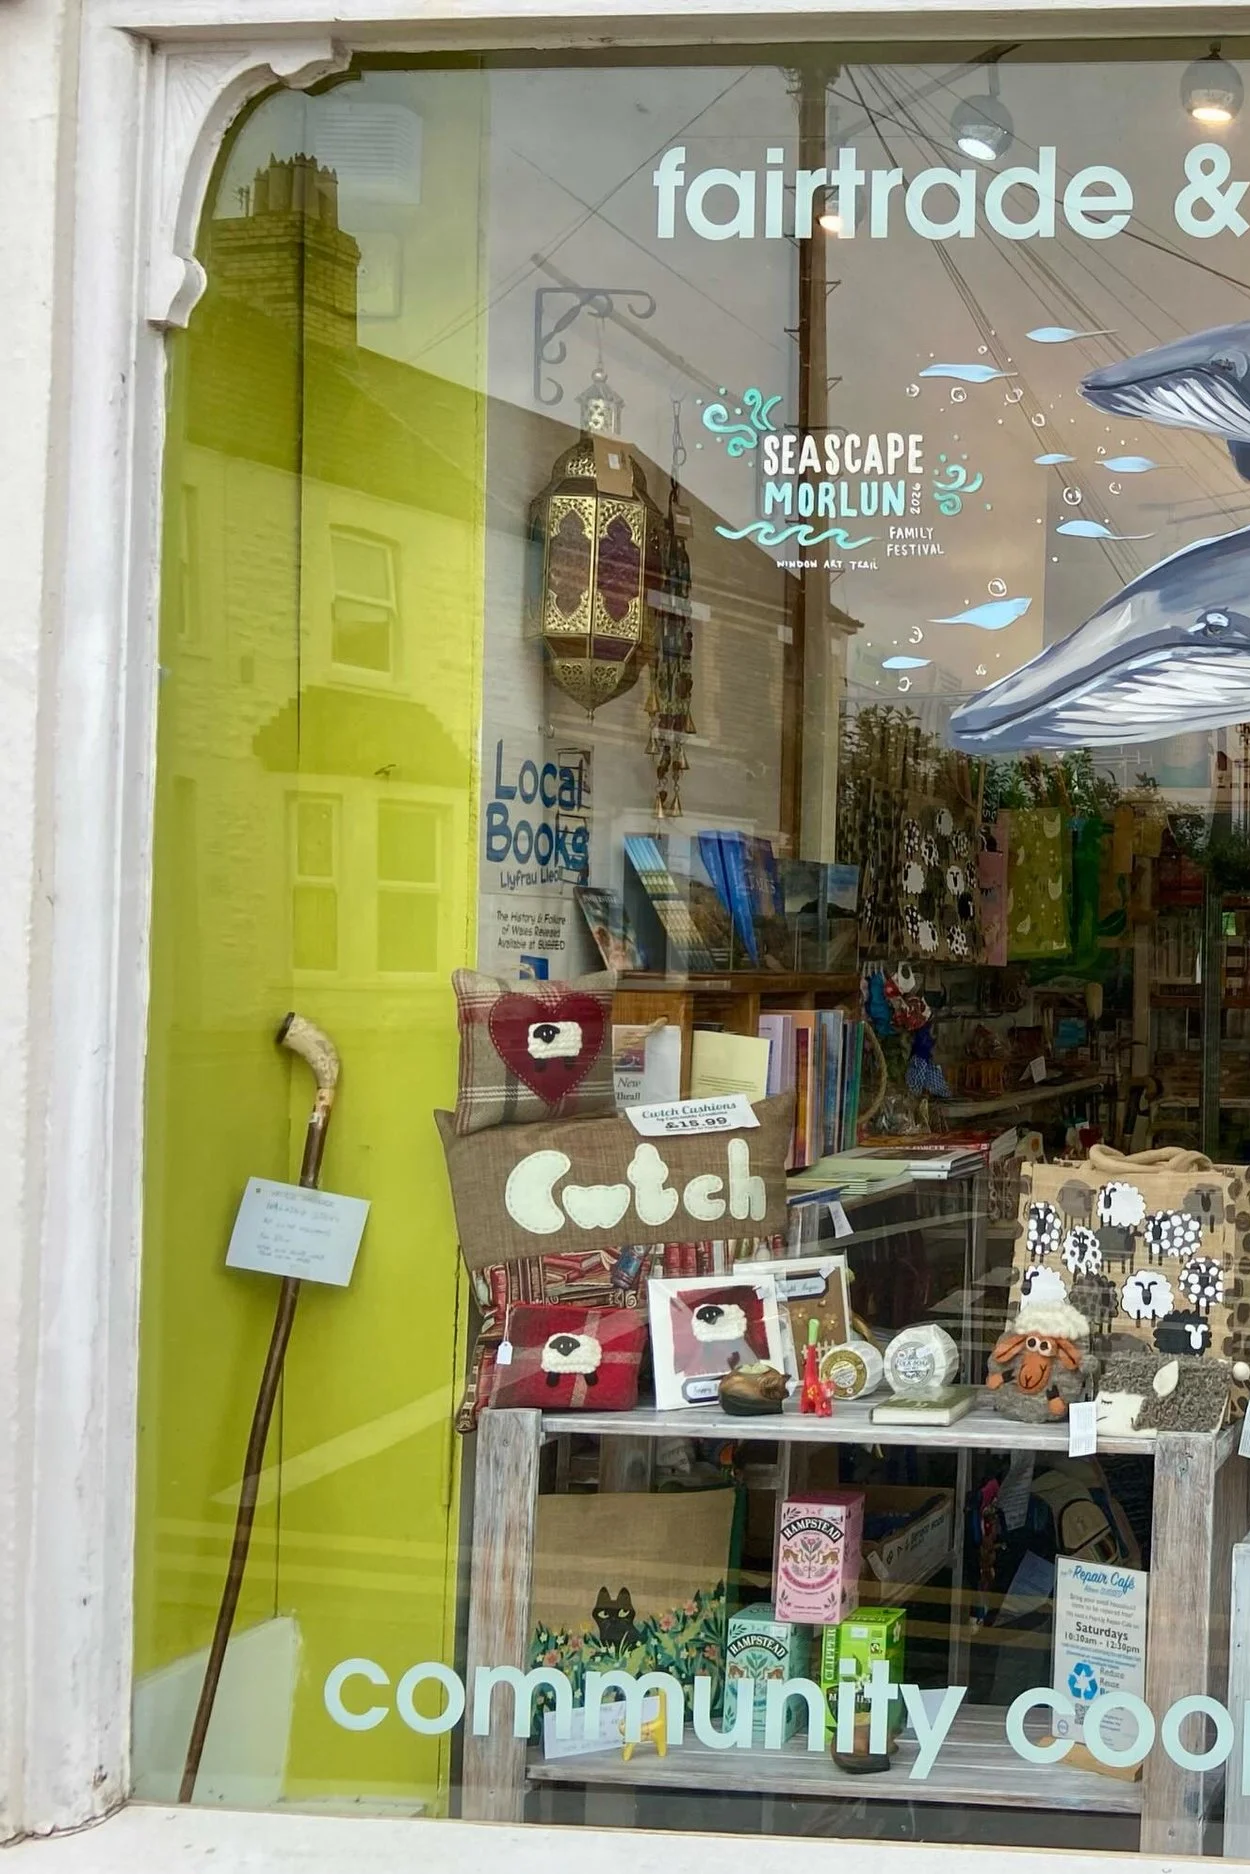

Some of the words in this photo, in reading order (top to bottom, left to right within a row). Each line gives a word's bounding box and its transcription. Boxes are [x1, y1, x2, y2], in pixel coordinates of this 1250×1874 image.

[653, 146, 1134, 240] fairtrade
[1174, 143, 1250, 238] &
[763, 433, 924, 476] SEASCAPE
[764, 480, 906, 517] MORLUN
[889, 526, 934, 540] FAMILY
[887, 543, 945, 557] FESTIVAL
[823, 559, 843, 569] ART
[495, 740, 584, 811] Local
[486, 801, 590, 872] Books
[500, 870, 538, 890] Llyfrau
[497, 910, 508, 920] The
[511, 911, 536, 924] History
[617, 1077, 641, 1088] New
[682, 1102, 737, 1115] Cushions
[505, 1138, 766, 1234] Cwtch
[783, 1517, 842, 1541] HAMPSTEAD
[1072, 1564, 1108, 1584] Repair
[1065, 1631, 1098, 1645] 10:30am
[1106, 1639, 1140, 1654] 12:30pm
[1075, 1621, 1129, 1645] Saturdays
[729, 1634, 786, 1659] HAMPSTEAD
[825, 1628, 837, 1680] CLIPPER
[323, 1656, 967, 1779] community
